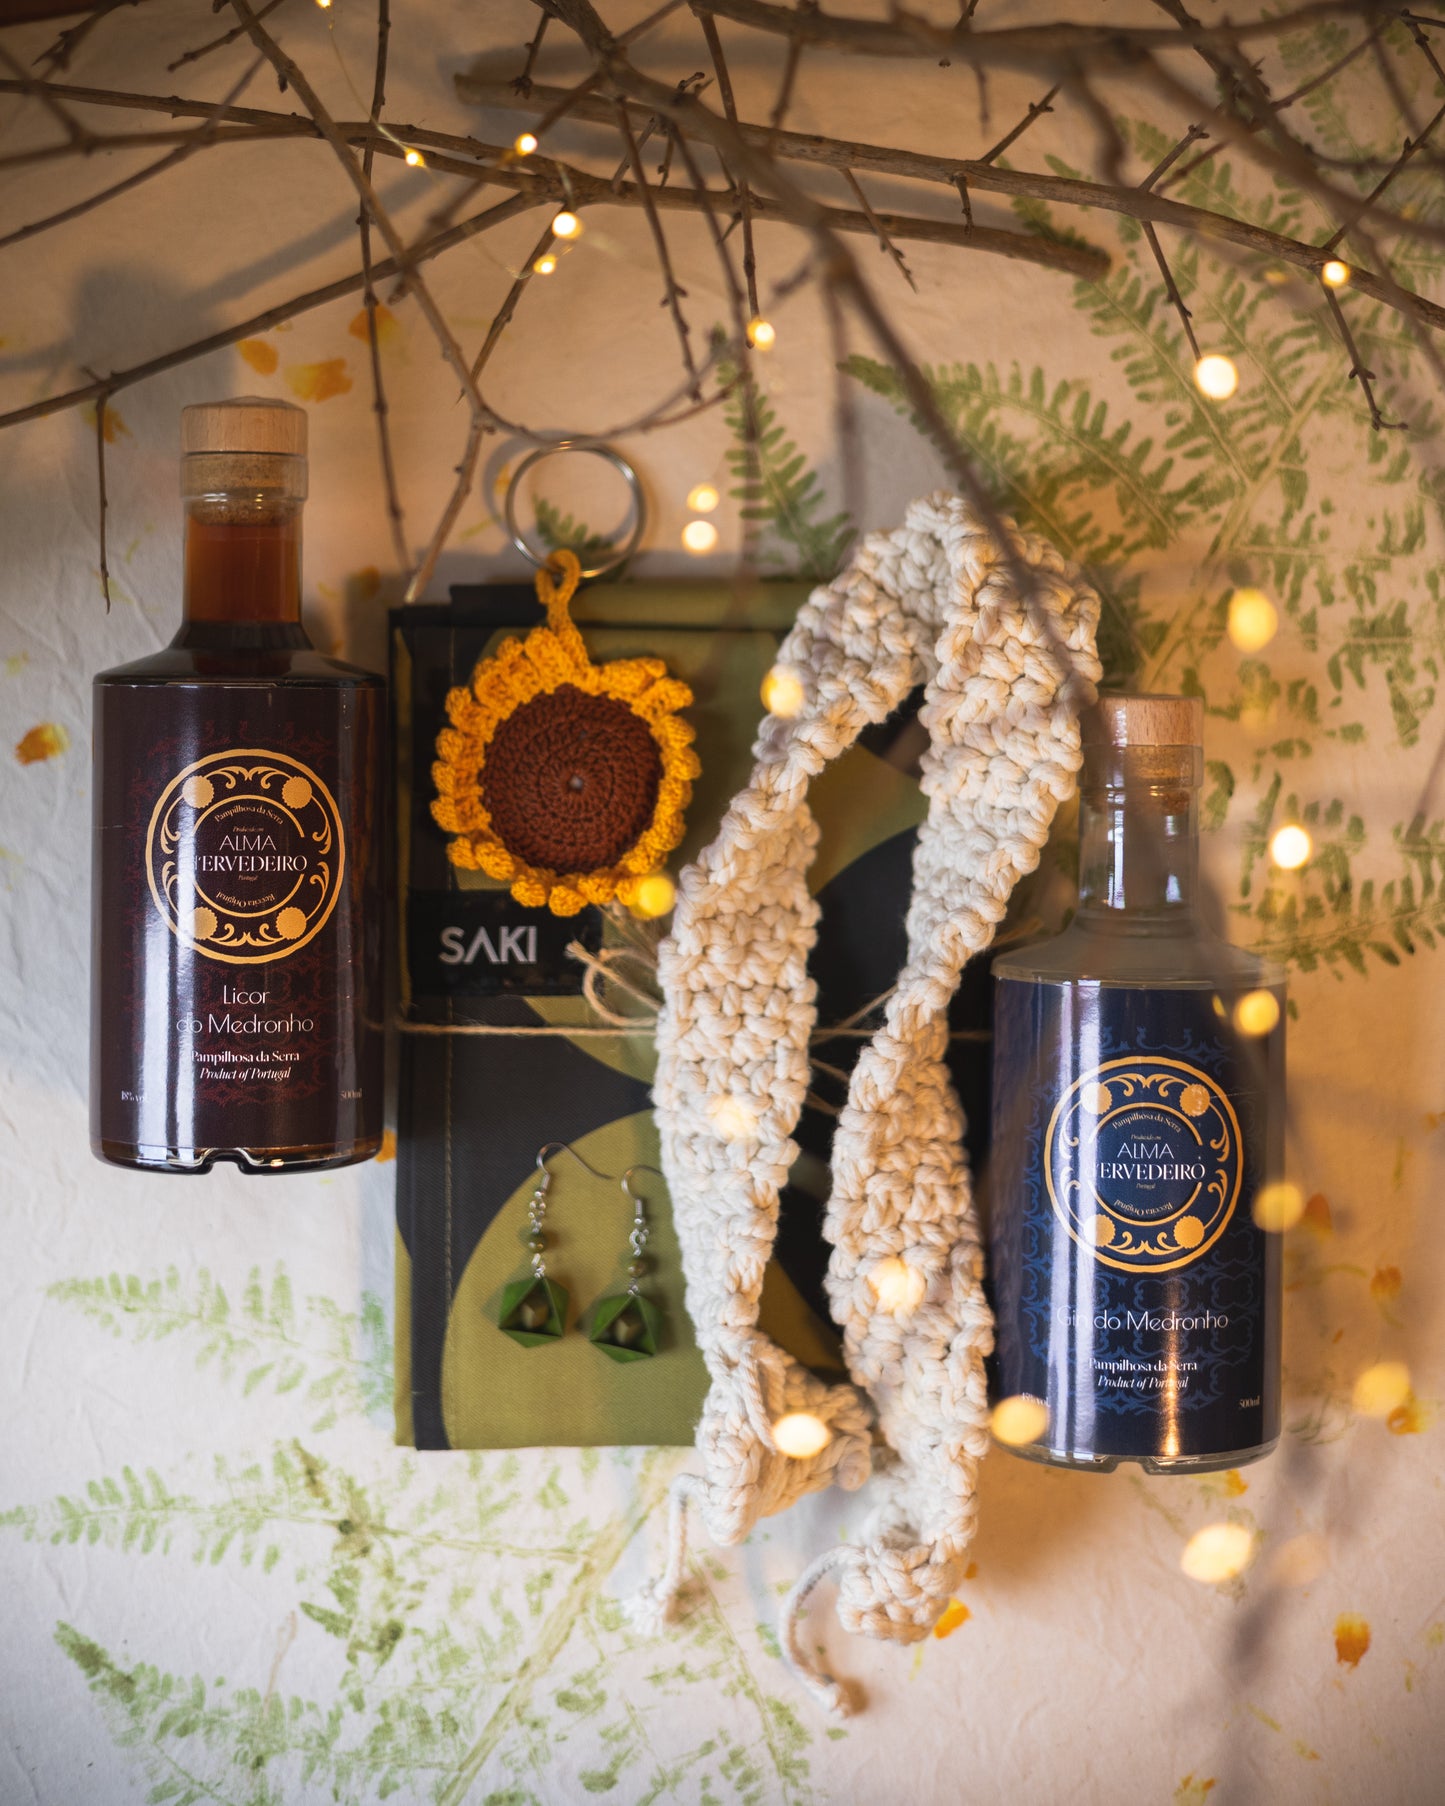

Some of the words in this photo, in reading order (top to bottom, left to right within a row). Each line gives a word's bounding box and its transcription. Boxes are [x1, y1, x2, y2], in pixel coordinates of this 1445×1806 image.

[214, 805, 256, 822] Pampilhosa
[257, 805, 266, 814] da
[266, 809, 284, 825] Serra
[219, 835, 277, 851] ALMA
[194, 855, 307, 872] 'ERVEDEIRO
[438, 926, 537, 964] SAKI
[223, 985, 270, 1005] Licor
[176, 1012, 203, 1034] do
[208, 1013, 314, 1034] Medronho
[191, 1050, 254, 1066] Pampilhosa
[256, 1050, 270, 1062] da
[271, 1050, 301, 1062] Serra
[200, 1067, 237, 1080] Product
[238, 1067, 252, 1083] of
[251, 1067, 292, 1082] Portugal
[1112, 1112, 1153, 1129] Pampilhosa
[1154, 1113, 1164, 1123] da
[1163, 1117, 1182, 1133] Serra
[1117, 1142, 1174, 1159] ALMA
[1095, 1163, 1206, 1180] 'ERVEDEIRO
[1094, 1310, 1121, 1330] do
[1127, 1310, 1229, 1331] Medronho
[1088, 1358, 1151, 1374] Pampilhosa
[1153, 1360, 1168, 1372] da
[1169, 1359, 1198, 1371] Serra
[1098, 1375, 1135, 1388] Product
[1136, 1376, 1150, 1391] of
[1149, 1376, 1189, 1390] Portgal
